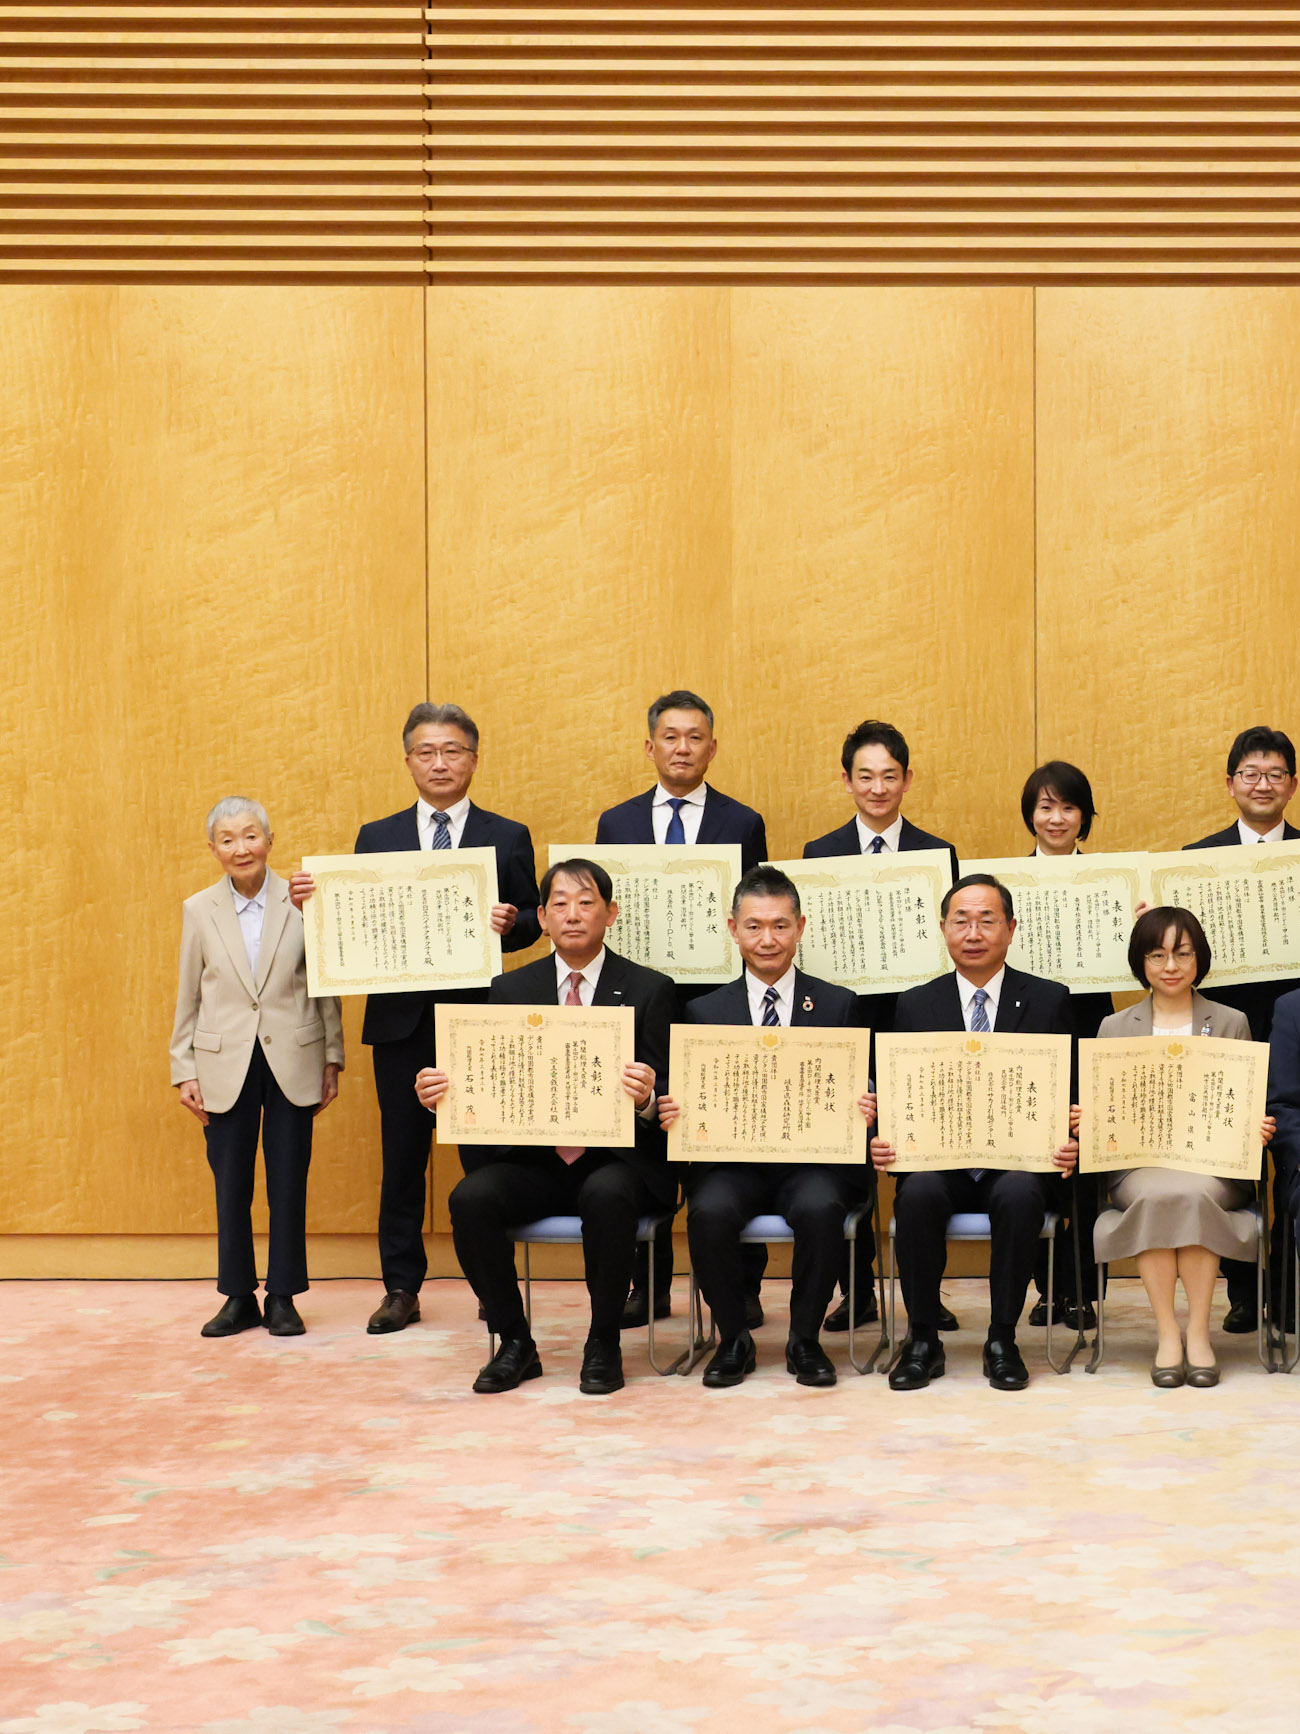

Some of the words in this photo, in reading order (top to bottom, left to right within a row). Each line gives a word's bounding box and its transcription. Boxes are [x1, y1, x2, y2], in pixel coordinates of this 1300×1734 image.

[1102, 890, 1110, 916] 準優勝
[1287, 876, 1295, 902] 準優勝
[463, 895, 475, 939] 表彰状
[706, 892, 718, 934] 表彰状
[914, 897, 927, 940] 表彰状
[1112, 900, 1124, 943] 表彰状
[590, 1055, 603, 1096] 表彰状
[824, 1072, 835, 1113] 表彰状
[1026, 1081, 1038, 1122] 表彰状
[1222, 1087, 1235, 1129] 表彰状
